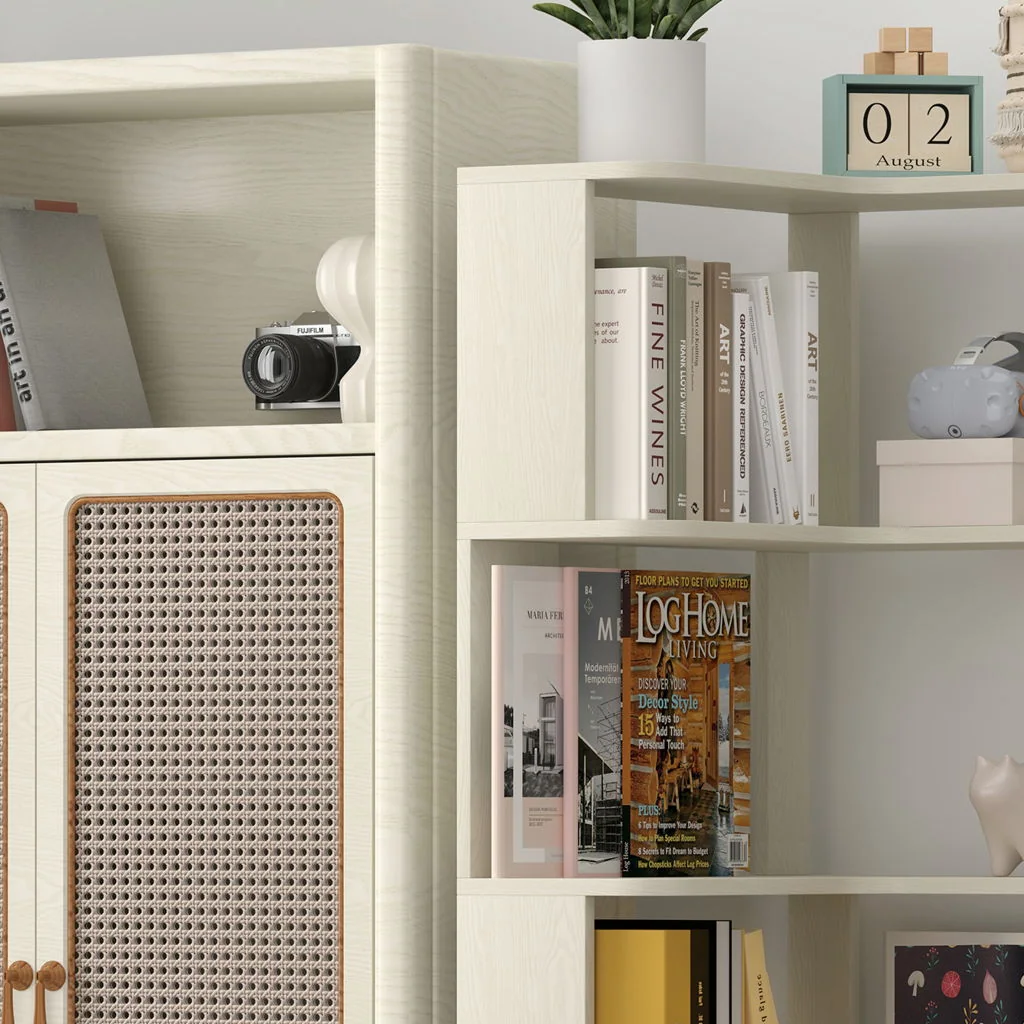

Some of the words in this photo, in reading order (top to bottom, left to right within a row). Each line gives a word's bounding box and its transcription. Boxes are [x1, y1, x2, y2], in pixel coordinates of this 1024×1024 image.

[863, 102, 891, 144] 0
[927, 103, 952, 144] 2
[876, 155, 942, 170] August
[0, 308, 15, 337] an
[652, 303, 664, 369] FINE
[719, 323, 730, 365] ART
[7, 341, 22, 365] in
[807, 332, 818, 372] ART
[14, 370, 33, 403] art
[759, 391, 771, 448] BORDEAUX
[778, 392, 788, 437] SAARINEN
[652, 385, 664, 485] WINES
[784, 440, 792, 463] EERO
[635, 575, 657, 586] FLOOR
[658, 576, 680, 587] PLANS
[680, 577, 691, 587] TO
[691, 577, 704, 588] GET
[705, 578, 719, 588] YOU
[720, 578, 749, 589] STARTED
[527, 610, 549, 620] MARIA
[669, 640, 718, 660] LIVING
[638, 677, 669, 690] DISCOVER
[669, 677, 687, 690] YOUR
[638, 693, 670, 710] Decor
[671, 694, 699, 714] Style
[638, 713, 655, 736] 15
[655, 713, 671, 725] Ways
[673, 714, 680, 724] to
[655, 726, 668, 737] Add
[670, 726, 684, 737] That
[638, 739, 665, 750] Personal
[666, 739, 685, 750] Touch
[638, 804, 661, 816] PLUS:
